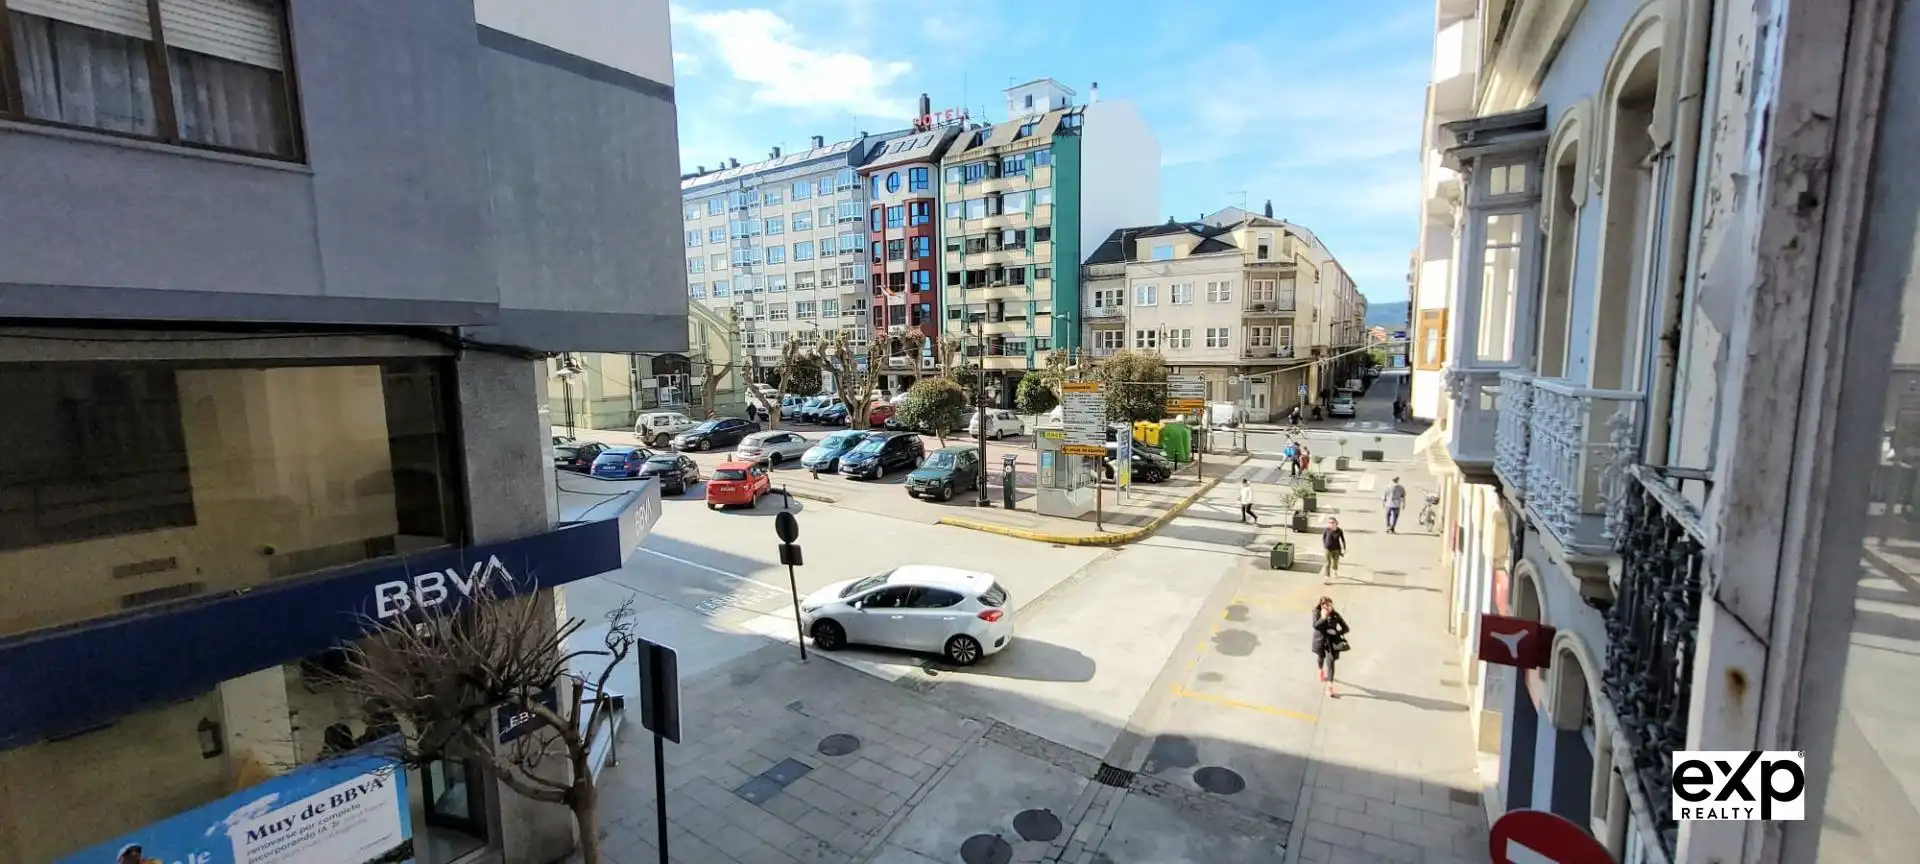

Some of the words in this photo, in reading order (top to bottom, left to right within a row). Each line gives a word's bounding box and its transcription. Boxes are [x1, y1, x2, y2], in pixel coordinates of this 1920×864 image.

[913, 107, 964, 126] HOTEL
[634, 496, 652, 536] BBVA
[375, 554, 513, 619] BBVA
[246, 815, 297, 845] Muy
[301, 803, 325, 821] de
[330, 777, 385, 809] BBVA
[247, 830, 297, 856] renovarse
[299, 822, 316, 835] por
[318, 803, 361, 826] completo
[248, 831, 316, 864] incorporando
